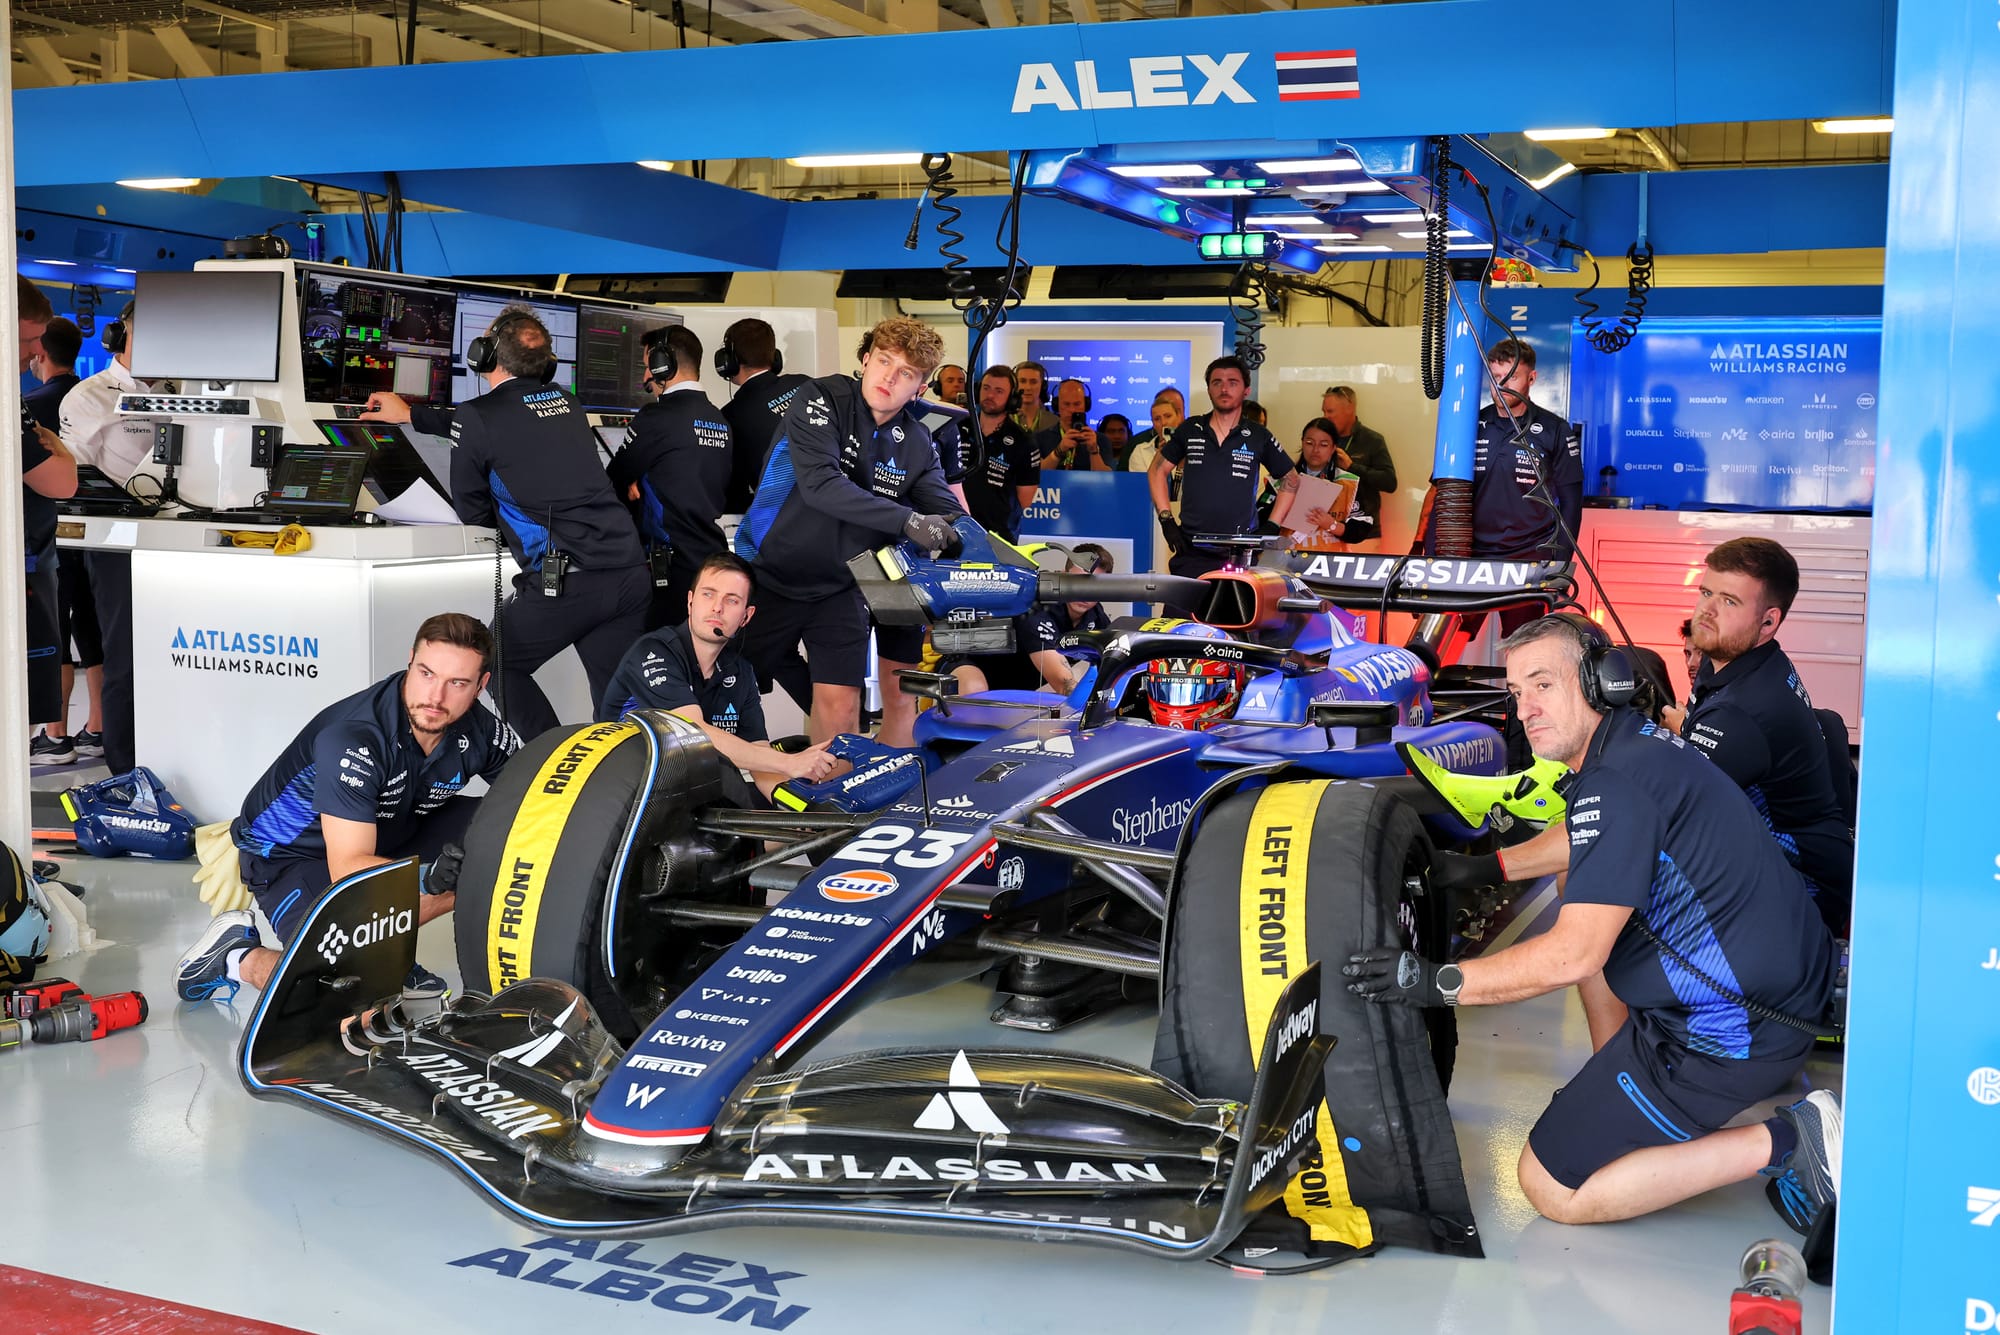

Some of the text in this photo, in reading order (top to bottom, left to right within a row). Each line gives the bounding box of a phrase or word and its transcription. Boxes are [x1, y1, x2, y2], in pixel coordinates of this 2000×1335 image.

[1011, 52, 1258, 113] ALEX
[1730, 343, 1848, 360] ATLASSIAN
[1709, 362, 1847, 374] WILLIAMS RACING
[522, 390, 563, 403] ATLASSIAN
[526, 398, 569, 410] WILLIAMS
[1689, 395, 1728, 404] KOMATSU
[536, 406, 571, 418] RACING
[693, 419, 728, 432] ATLASSIAN
[694, 427, 729, 441] WILLIAMS
[1625, 429, 1664, 437] DURACELL
[1673, 428, 1712, 440] Stephens
[1771, 428, 1796, 439] airia
[698, 437, 725, 448] RACING
[1804, 429, 1834, 442] brillio
[950, 570, 1009, 580] KOMATSU
[1303, 555, 1529, 586] ATLASSIAN
[1353, 616, 1366, 637] 23
[192, 629, 319, 658] ATLASSIAN
[1217, 646, 1244, 660] airia
[171, 653, 319, 679] WILLIAMS RACING
[711, 720, 738, 728] WILLIA
[991, 748, 1075, 759] ATLASSIAN
[543, 743, 595, 795] RIGHT
[842, 753, 914, 794] KOMATSU
[340, 773, 364, 788] brillio
[111, 815, 172, 833] KOMATSU
[1111, 796, 1192, 847] Stephens
[832, 825, 973, 869] 23
[825, 878, 893, 893] Gulf
[499, 857, 534, 941] FRONT
[1259, 825, 1293, 979] LEFT FRONT
[770, 907, 873, 927] KOMATSU
[353, 907, 412, 948] airia
[787, 933, 835, 943] INGENUITY
[743, 945, 817, 963] betway
[498, 946, 519, 990] GHT
[726, 966, 787, 984] brillio
[723, 993, 771, 1006] VAST
[690, 1012, 749, 1026] KEEPER
[1275, 997, 1318, 1064] betway
[649, 1029, 727, 1052] Reviva
[625, 1054, 708, 1078] PIRELLI
[397, 1052, 562, 1141] ATLASSIAN
[300, 1082, 500, 1163] MYPROTEIN
[1292, 1105, 1315, 1144] CITY
[742, 1153, 1169, 1184] ATLASSIAN
[952, 1206, 1187, 1241] ROTEIN
[521, 1236, 809, 1298] ALEX
[445, 1247, 812, 1332] ALBON
